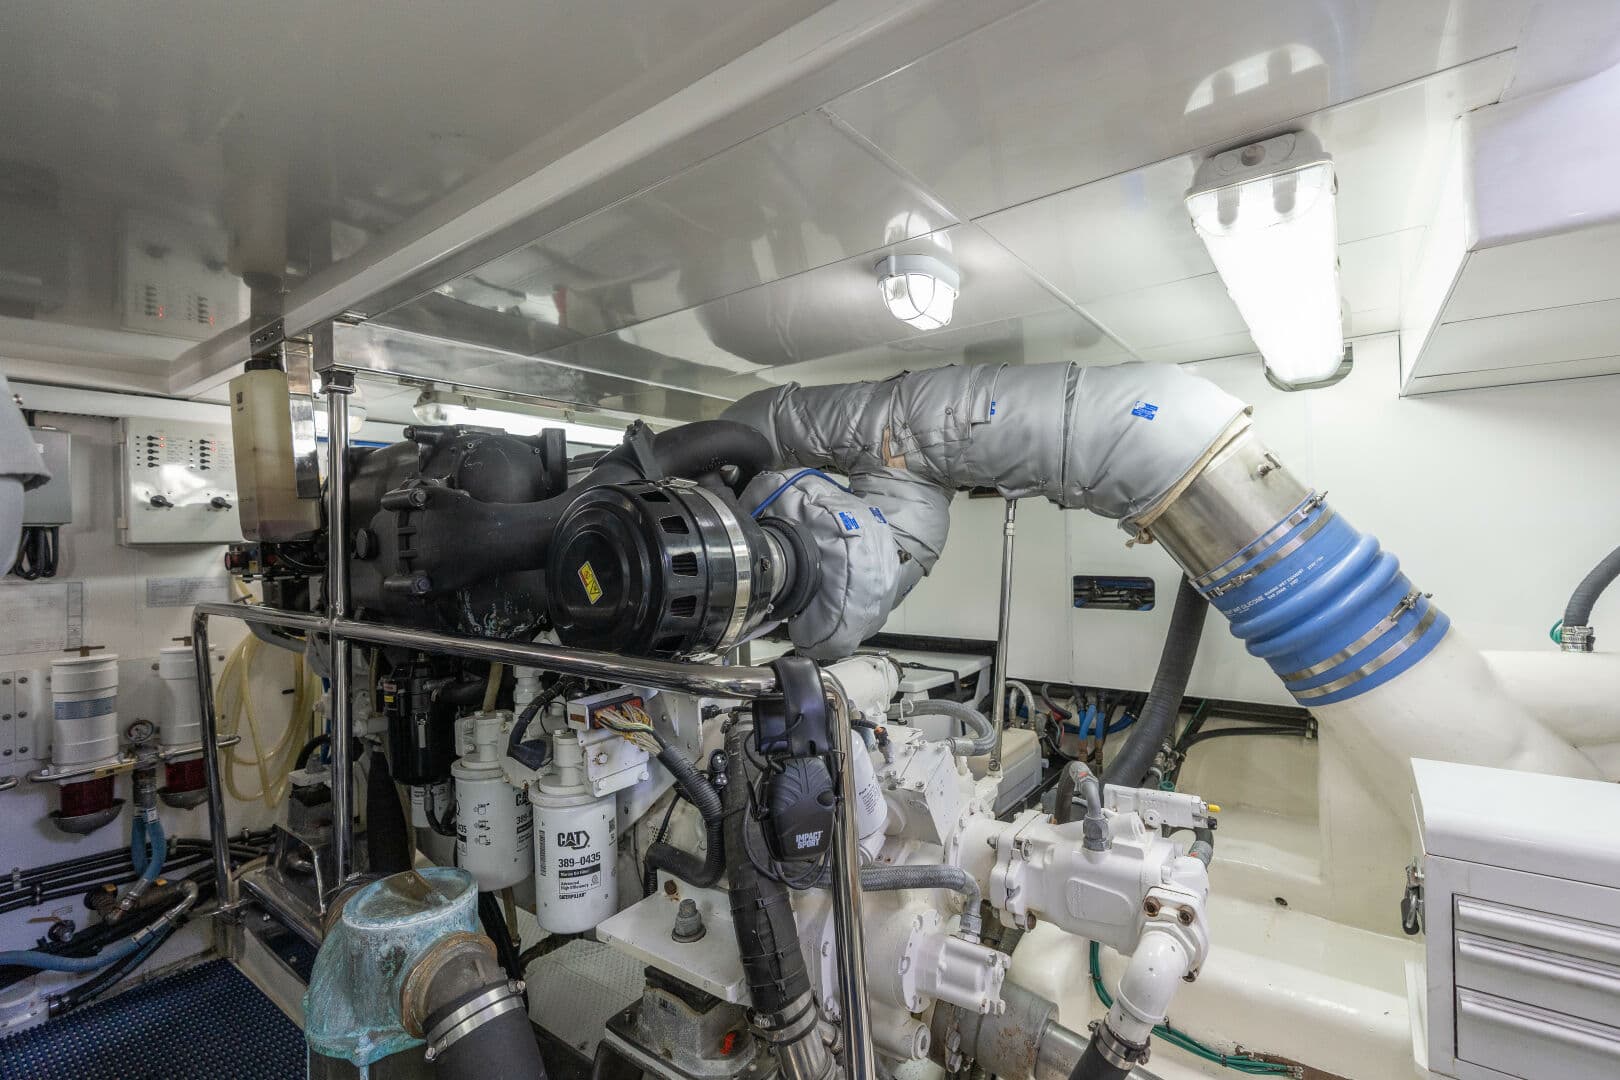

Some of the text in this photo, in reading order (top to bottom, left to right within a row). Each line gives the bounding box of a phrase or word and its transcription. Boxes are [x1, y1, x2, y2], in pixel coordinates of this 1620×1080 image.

[557, 831, 587, 848] CAT
[796, 831, 822, 843] IMPACT
[798, 839, 819, 849] SPORT
[558, 852, 601, 868] 389-0435
